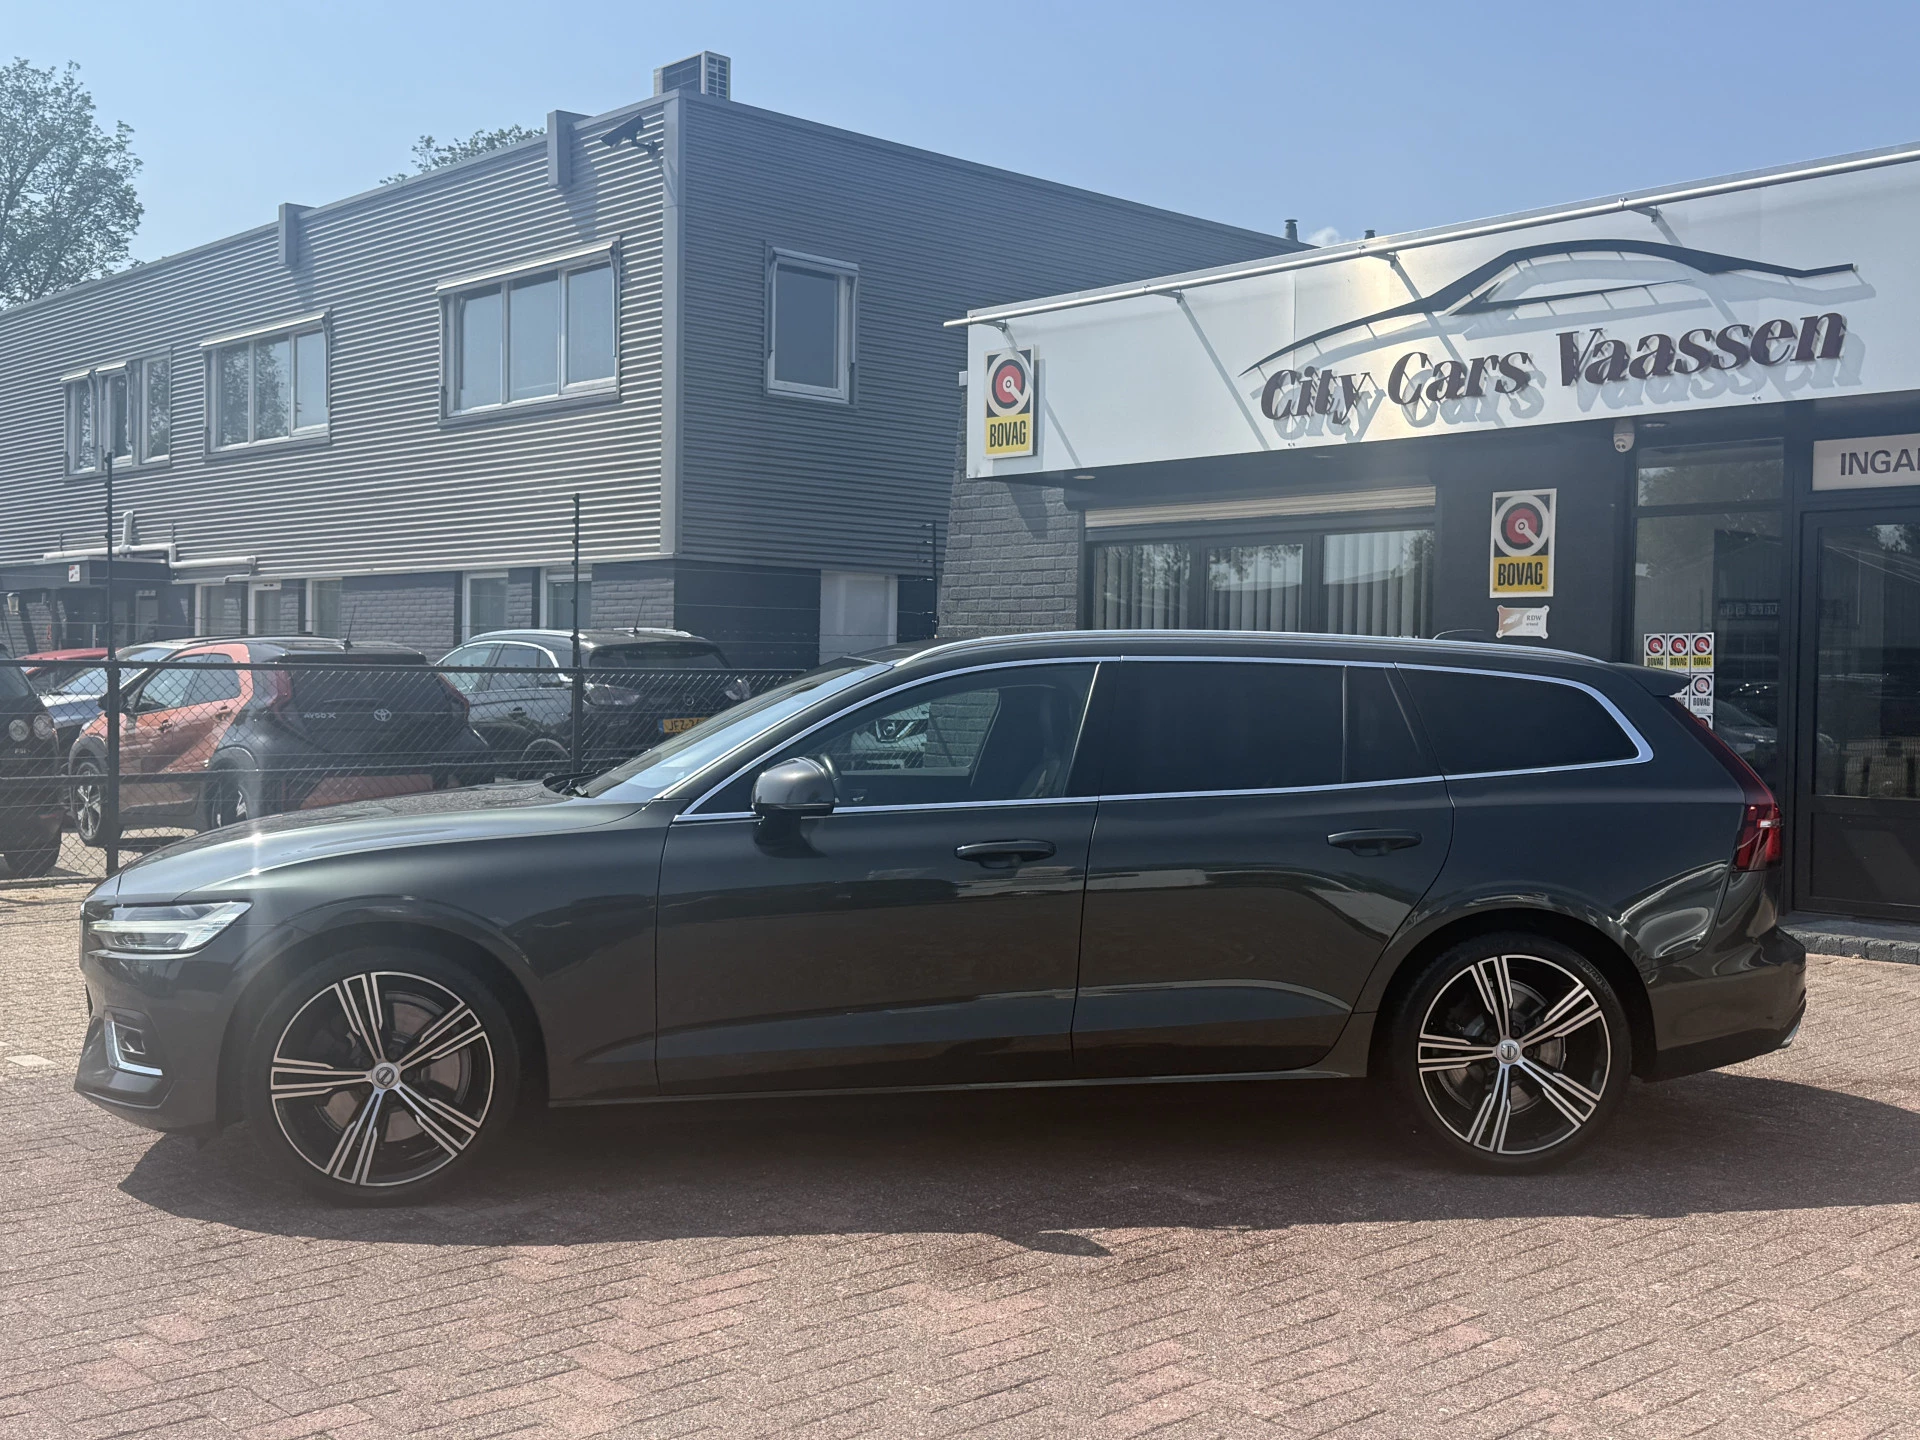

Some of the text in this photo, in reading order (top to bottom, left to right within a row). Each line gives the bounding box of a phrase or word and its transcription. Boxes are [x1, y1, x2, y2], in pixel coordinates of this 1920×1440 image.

[1260, 312, 1846, 425] City Cars Vaassen
[989, 420, 1027, 448] BOVAG
[1840, 447, 1920, 476] INGA
[1497, 561, 1543, 587] BOVAG
[1669, 657, 1687, 667] BOVAG
[1693, 656, 1711, 667] BOVAG
[1692, 697, 1711, 707] BOVAG
